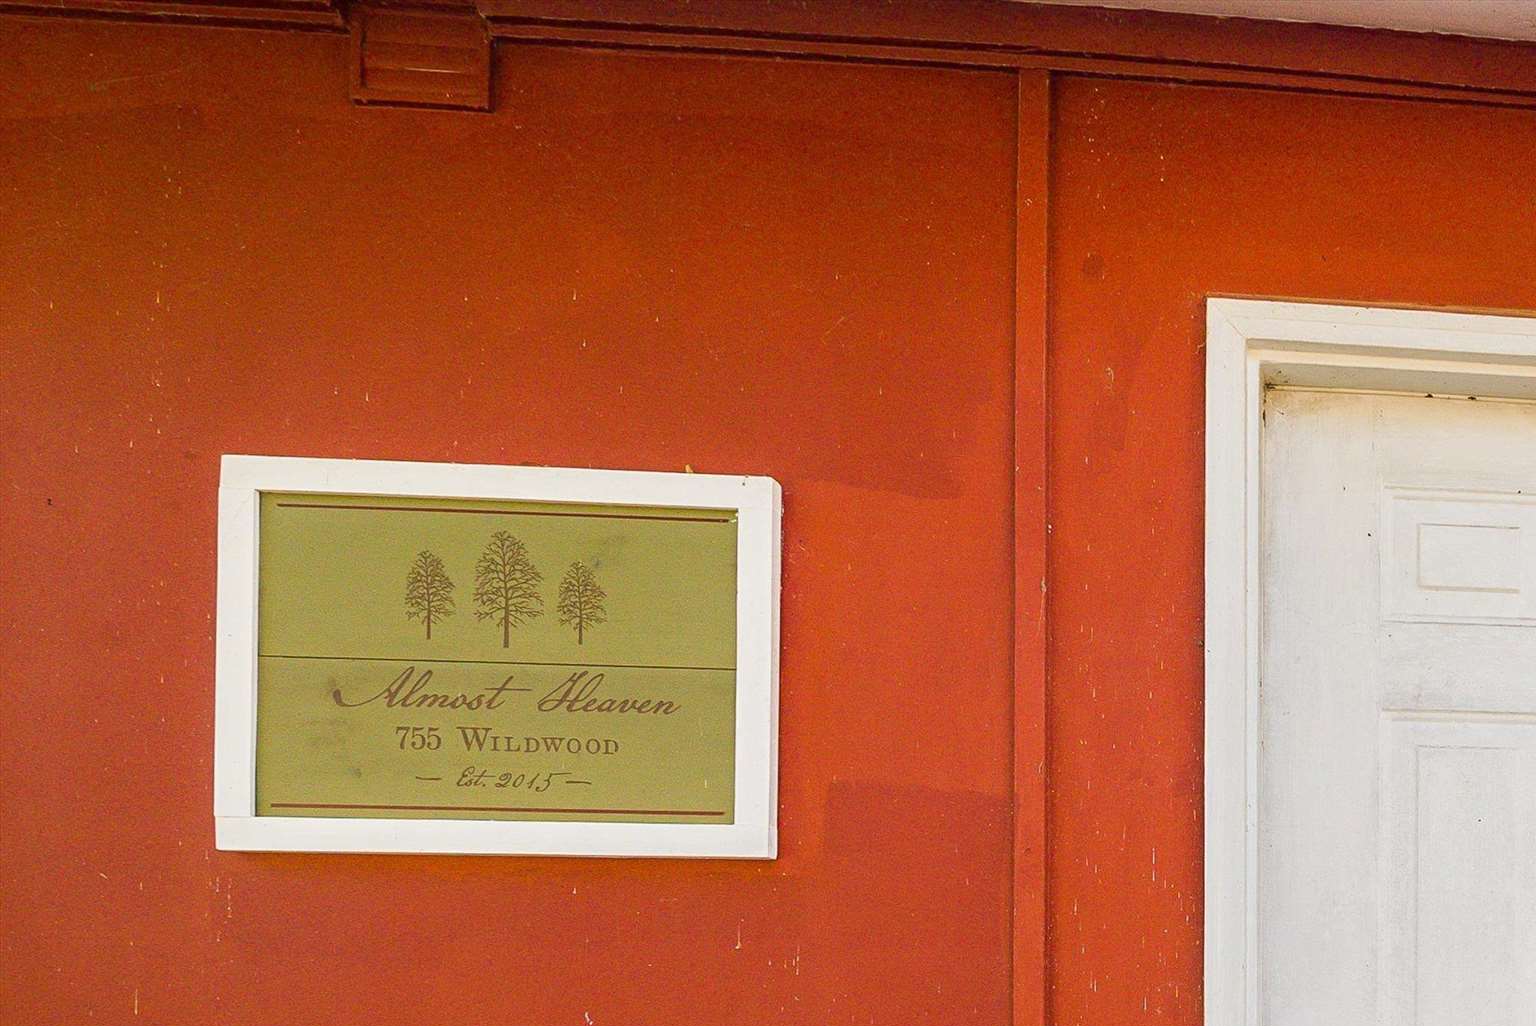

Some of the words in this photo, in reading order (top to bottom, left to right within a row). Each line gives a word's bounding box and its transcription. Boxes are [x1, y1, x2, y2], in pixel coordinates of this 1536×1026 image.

[332, 665, 533, 711] Almost
[536, 670, 682, 715] Heaven
[395, 726, 442, 751] 755
[455, 726, 620, 755] WILDWOOD
[456, 766, 496, 788] Est.
[495, 771, 573, 793] 2015
